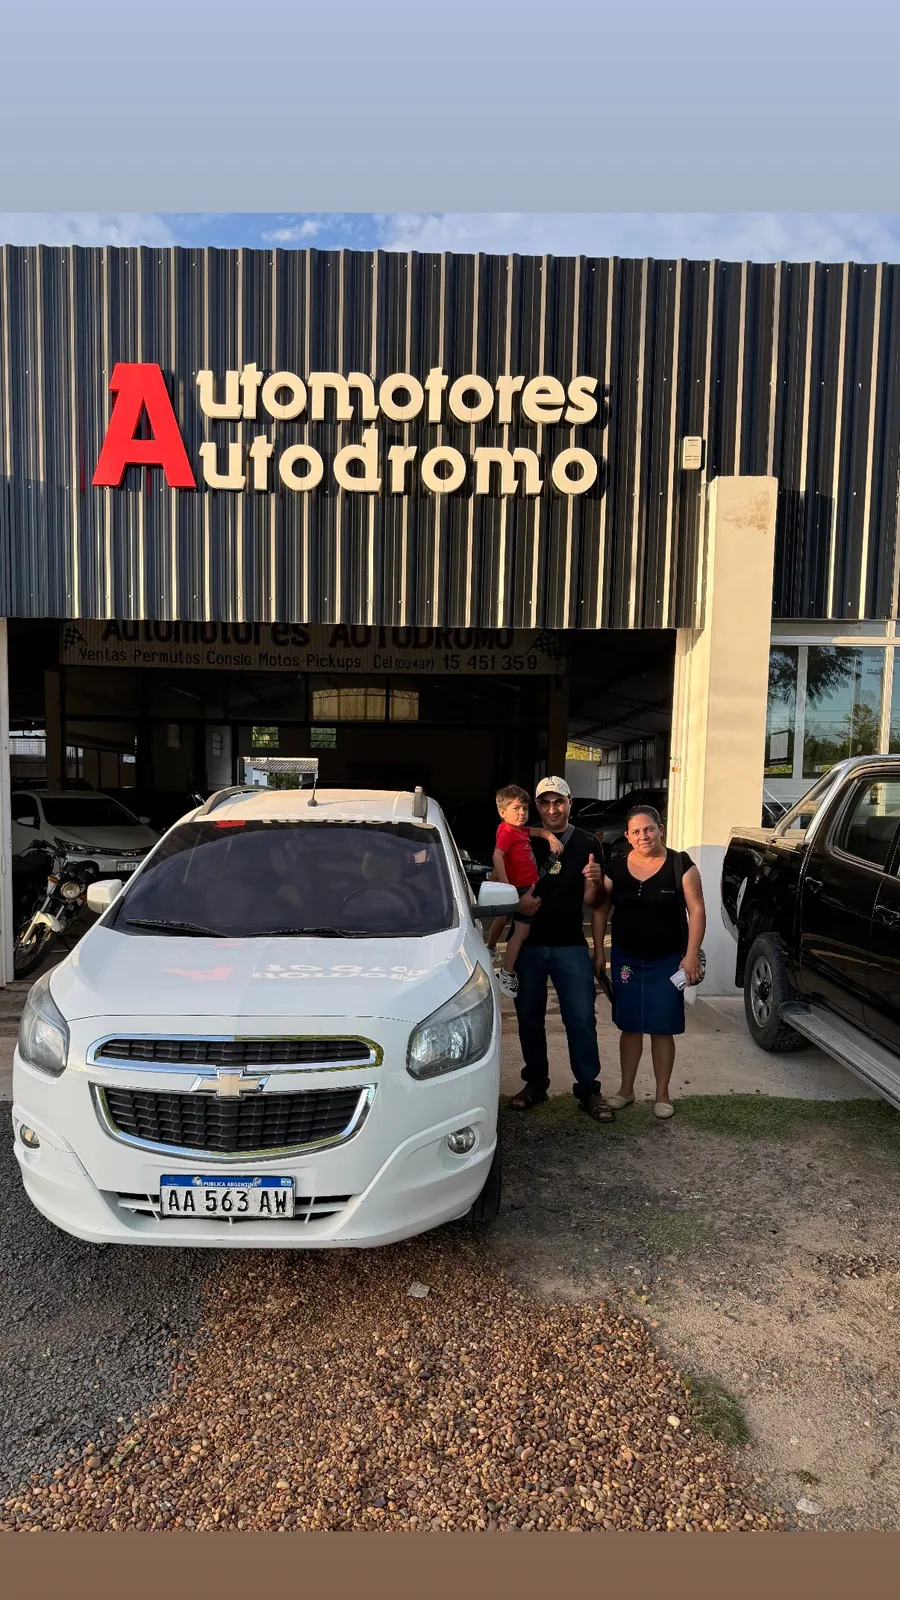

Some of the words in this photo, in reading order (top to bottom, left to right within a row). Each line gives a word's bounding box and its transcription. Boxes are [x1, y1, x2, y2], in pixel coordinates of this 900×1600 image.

[79, 647, 127, 661] Ventas
[133, 649, 200, 664] Permutas
[443, 654, 460, 669] 15
[467, 654, 495, 670] 451
[501, 654, 538, 671] 359
[168, 1189, 196, 1212] AA
[205, 1189, 249, 1212] 563
[259, 1190, 288, 1213] AW
